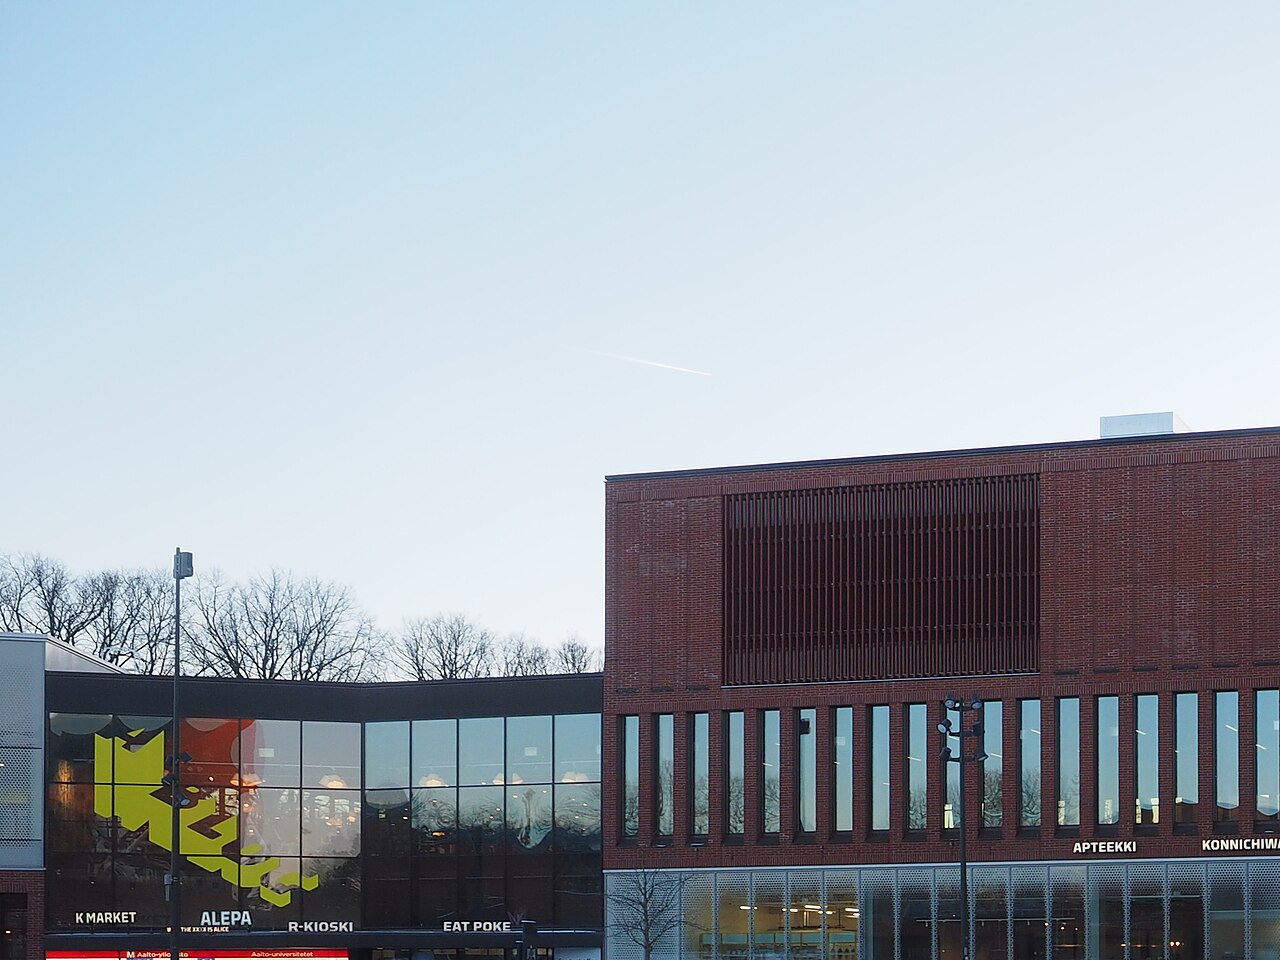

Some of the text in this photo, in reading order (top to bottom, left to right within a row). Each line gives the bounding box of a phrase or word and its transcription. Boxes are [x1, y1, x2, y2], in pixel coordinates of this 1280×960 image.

[1073, 841, 1136, 853] APTEEKKI
[75, 912, 137, 923] K MARKET
[200, 910, 252, 925] ALEPA
[288, 921, 353, 932] R-KIOSKI
[443, 921, 511, 931] EAT POKE
